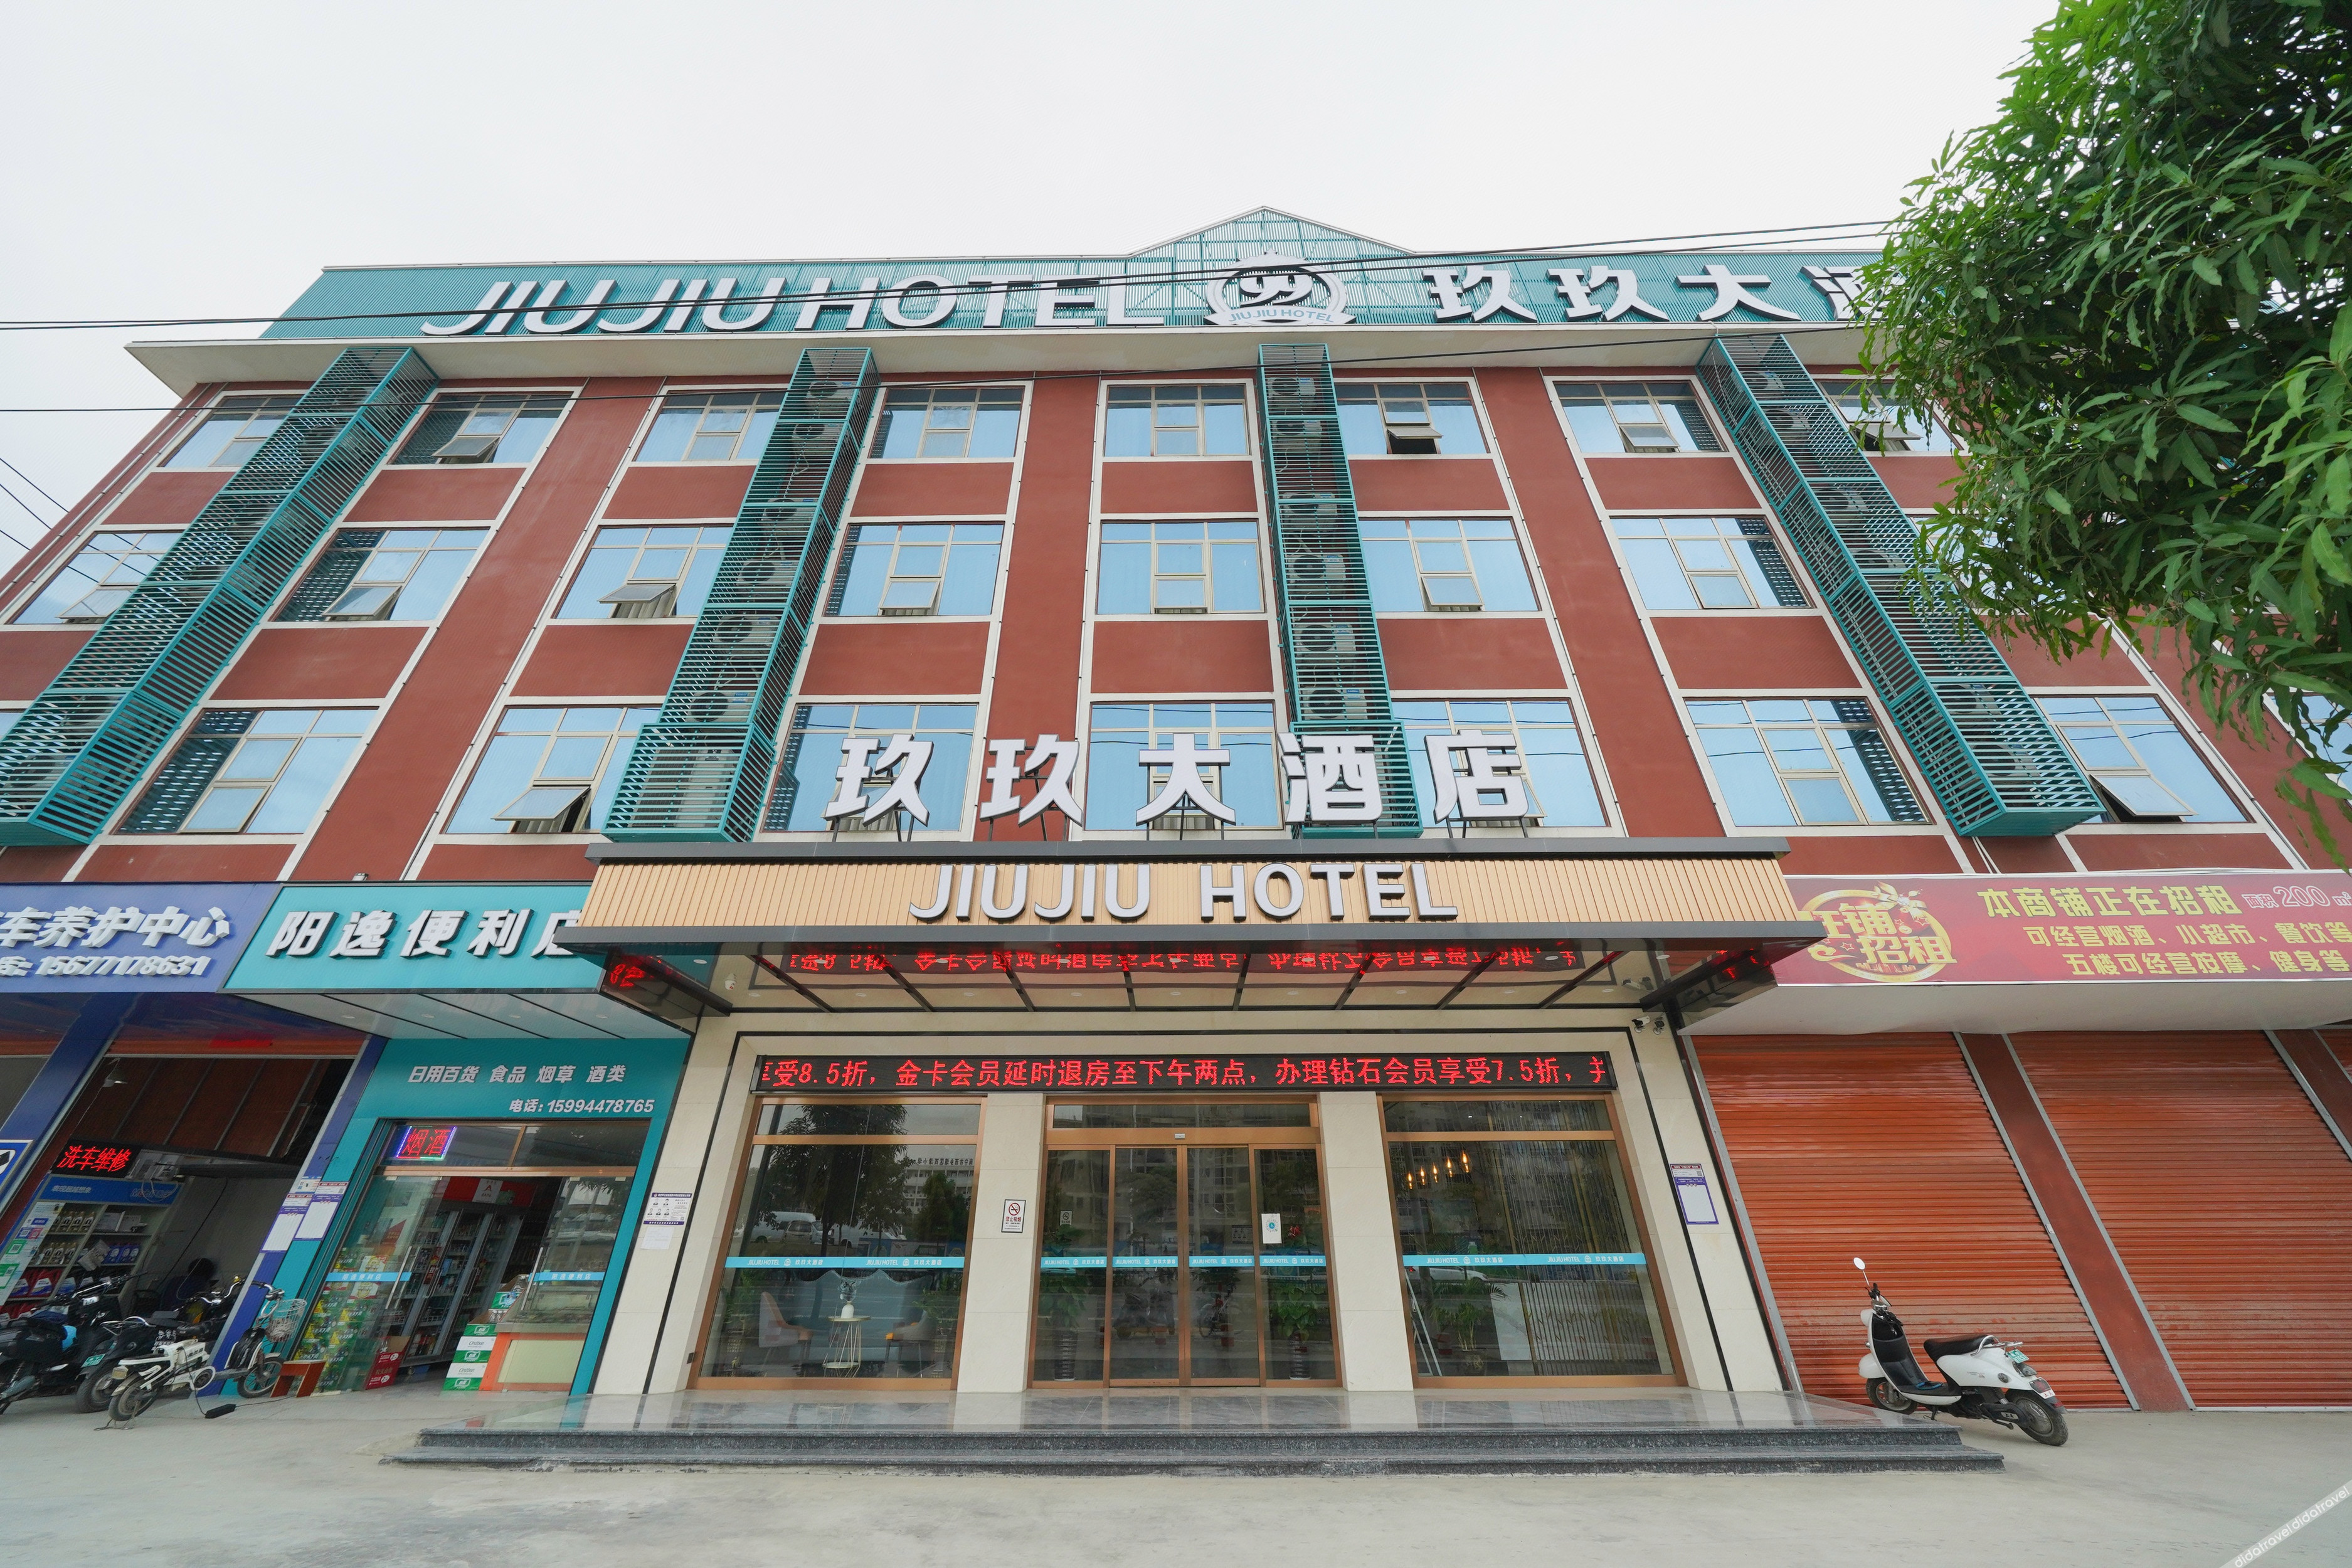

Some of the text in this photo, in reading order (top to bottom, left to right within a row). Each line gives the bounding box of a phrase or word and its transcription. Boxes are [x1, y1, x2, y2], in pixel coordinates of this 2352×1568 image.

[1229, 309, 1334, 322] JIUJIU HOTEL
[825, 729, 1530, 826] 玖玖大酒店
[909, 862, 1458, 921] JIUJIU HOTEL
[1977, 885, 2243, 918] 本商铺正在招租
[0, 906, 230, 948] 车养护中心
[2022, 921, 2352, 946] 可经营烟酒、小超市、餐饮等
[1857, 935, 1957, 964] 招租
[2062, 950, 2351, 975] 五楼可经营按摩、健身等
[408, 1065, 626, 1083] 日用百货 食品 烟草 酒类
[402, 1128, 451, 1157] 烟酒
[57, 1145, 132, 1172] 洗车维修
